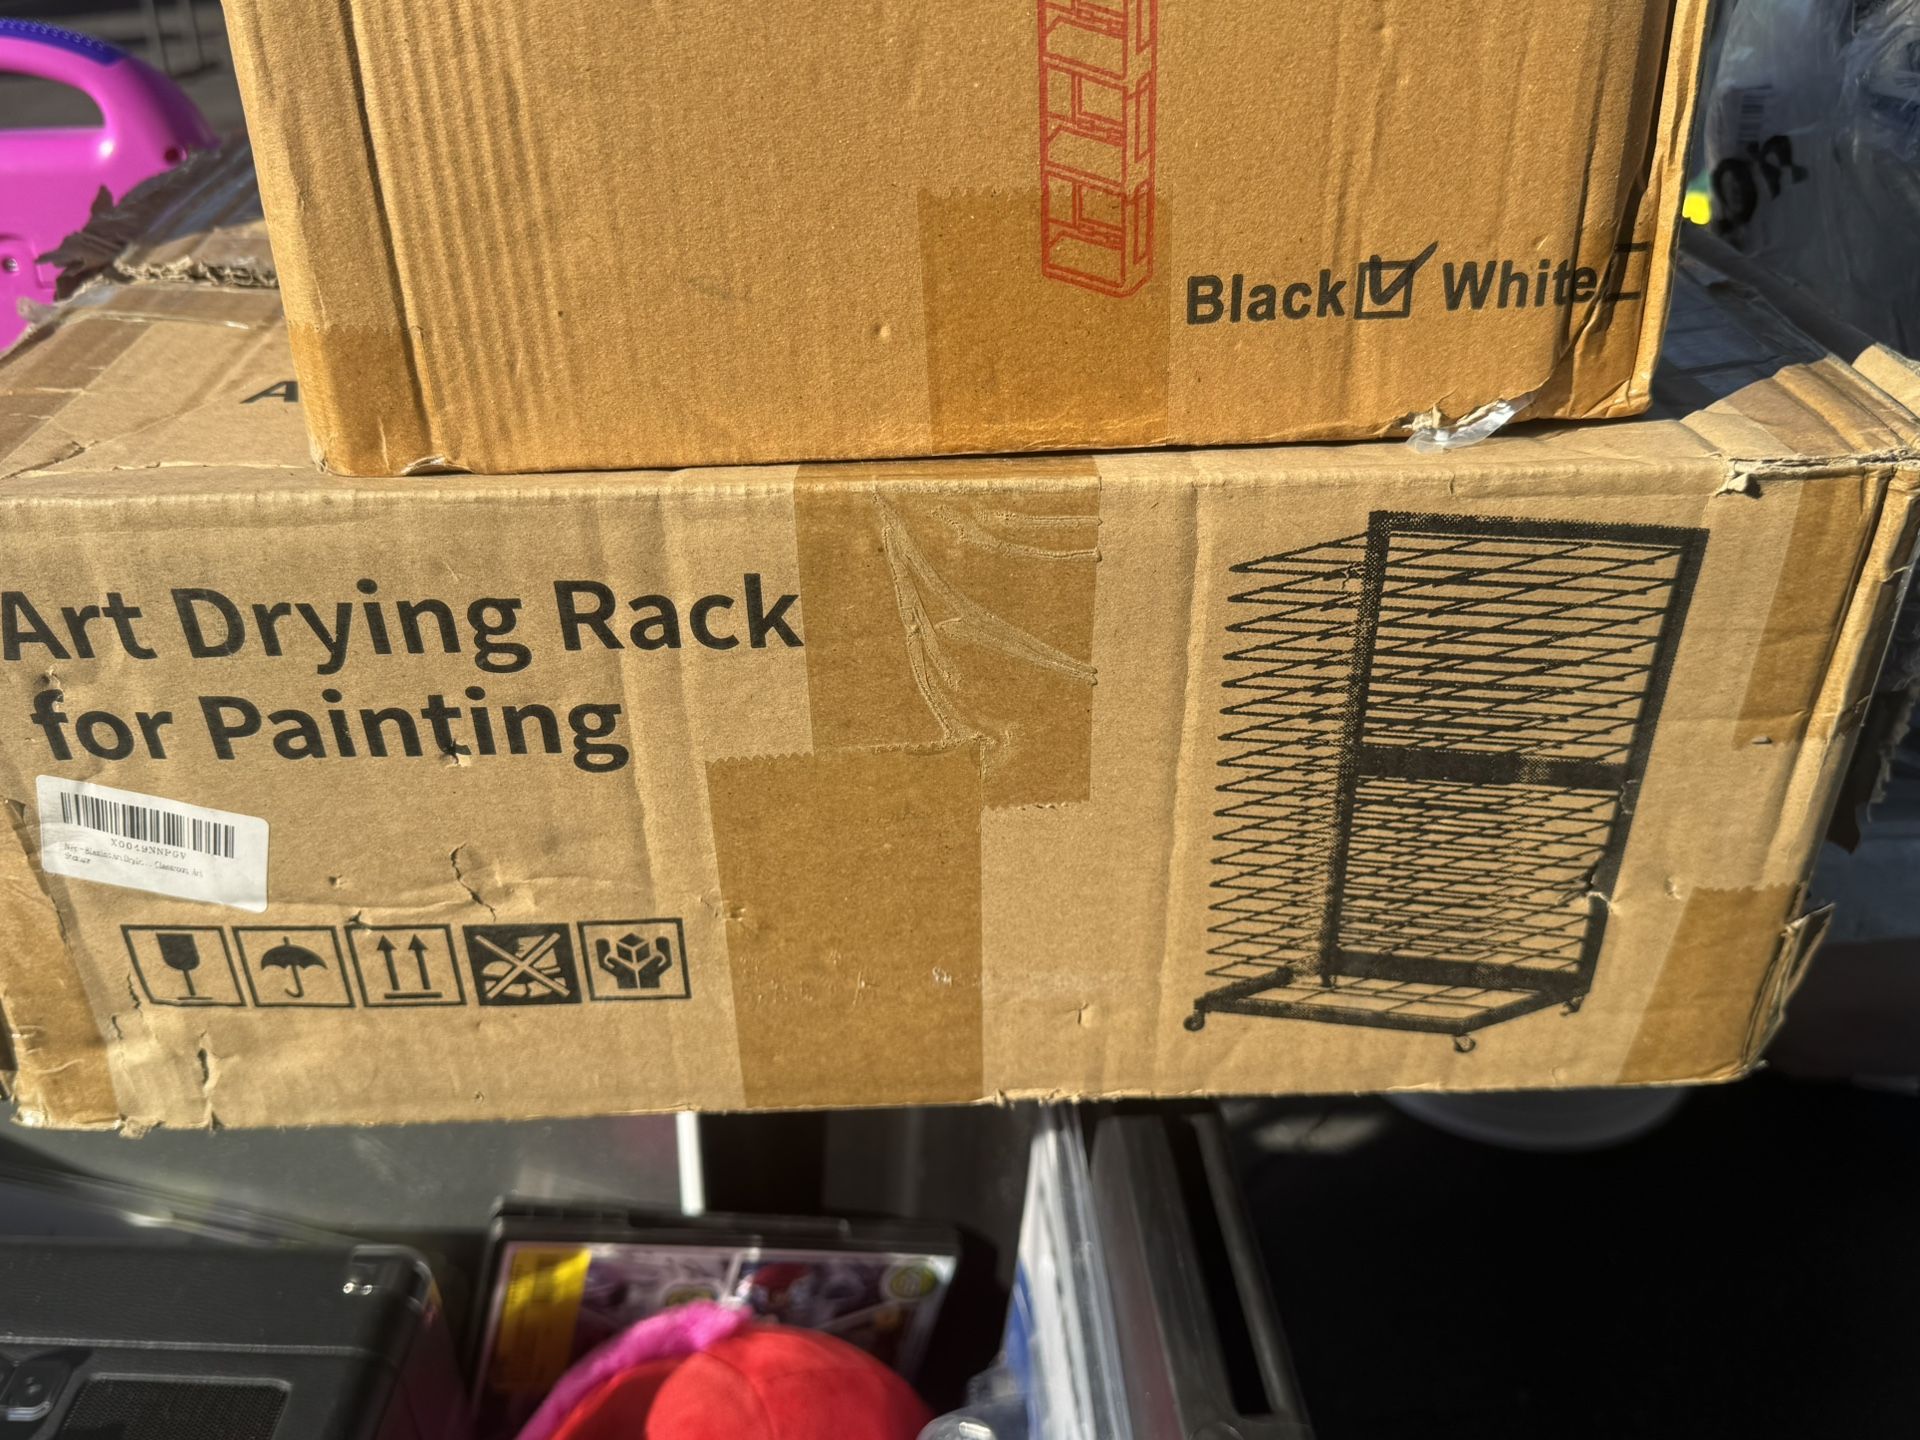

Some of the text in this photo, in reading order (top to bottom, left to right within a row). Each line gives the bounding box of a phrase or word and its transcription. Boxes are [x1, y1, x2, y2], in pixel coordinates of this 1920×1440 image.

[1187, 259, 1597, 325] Black White
[1, 573, 804, 674] Art Drying Rack
[30, 686, 629, 773] for Painting
